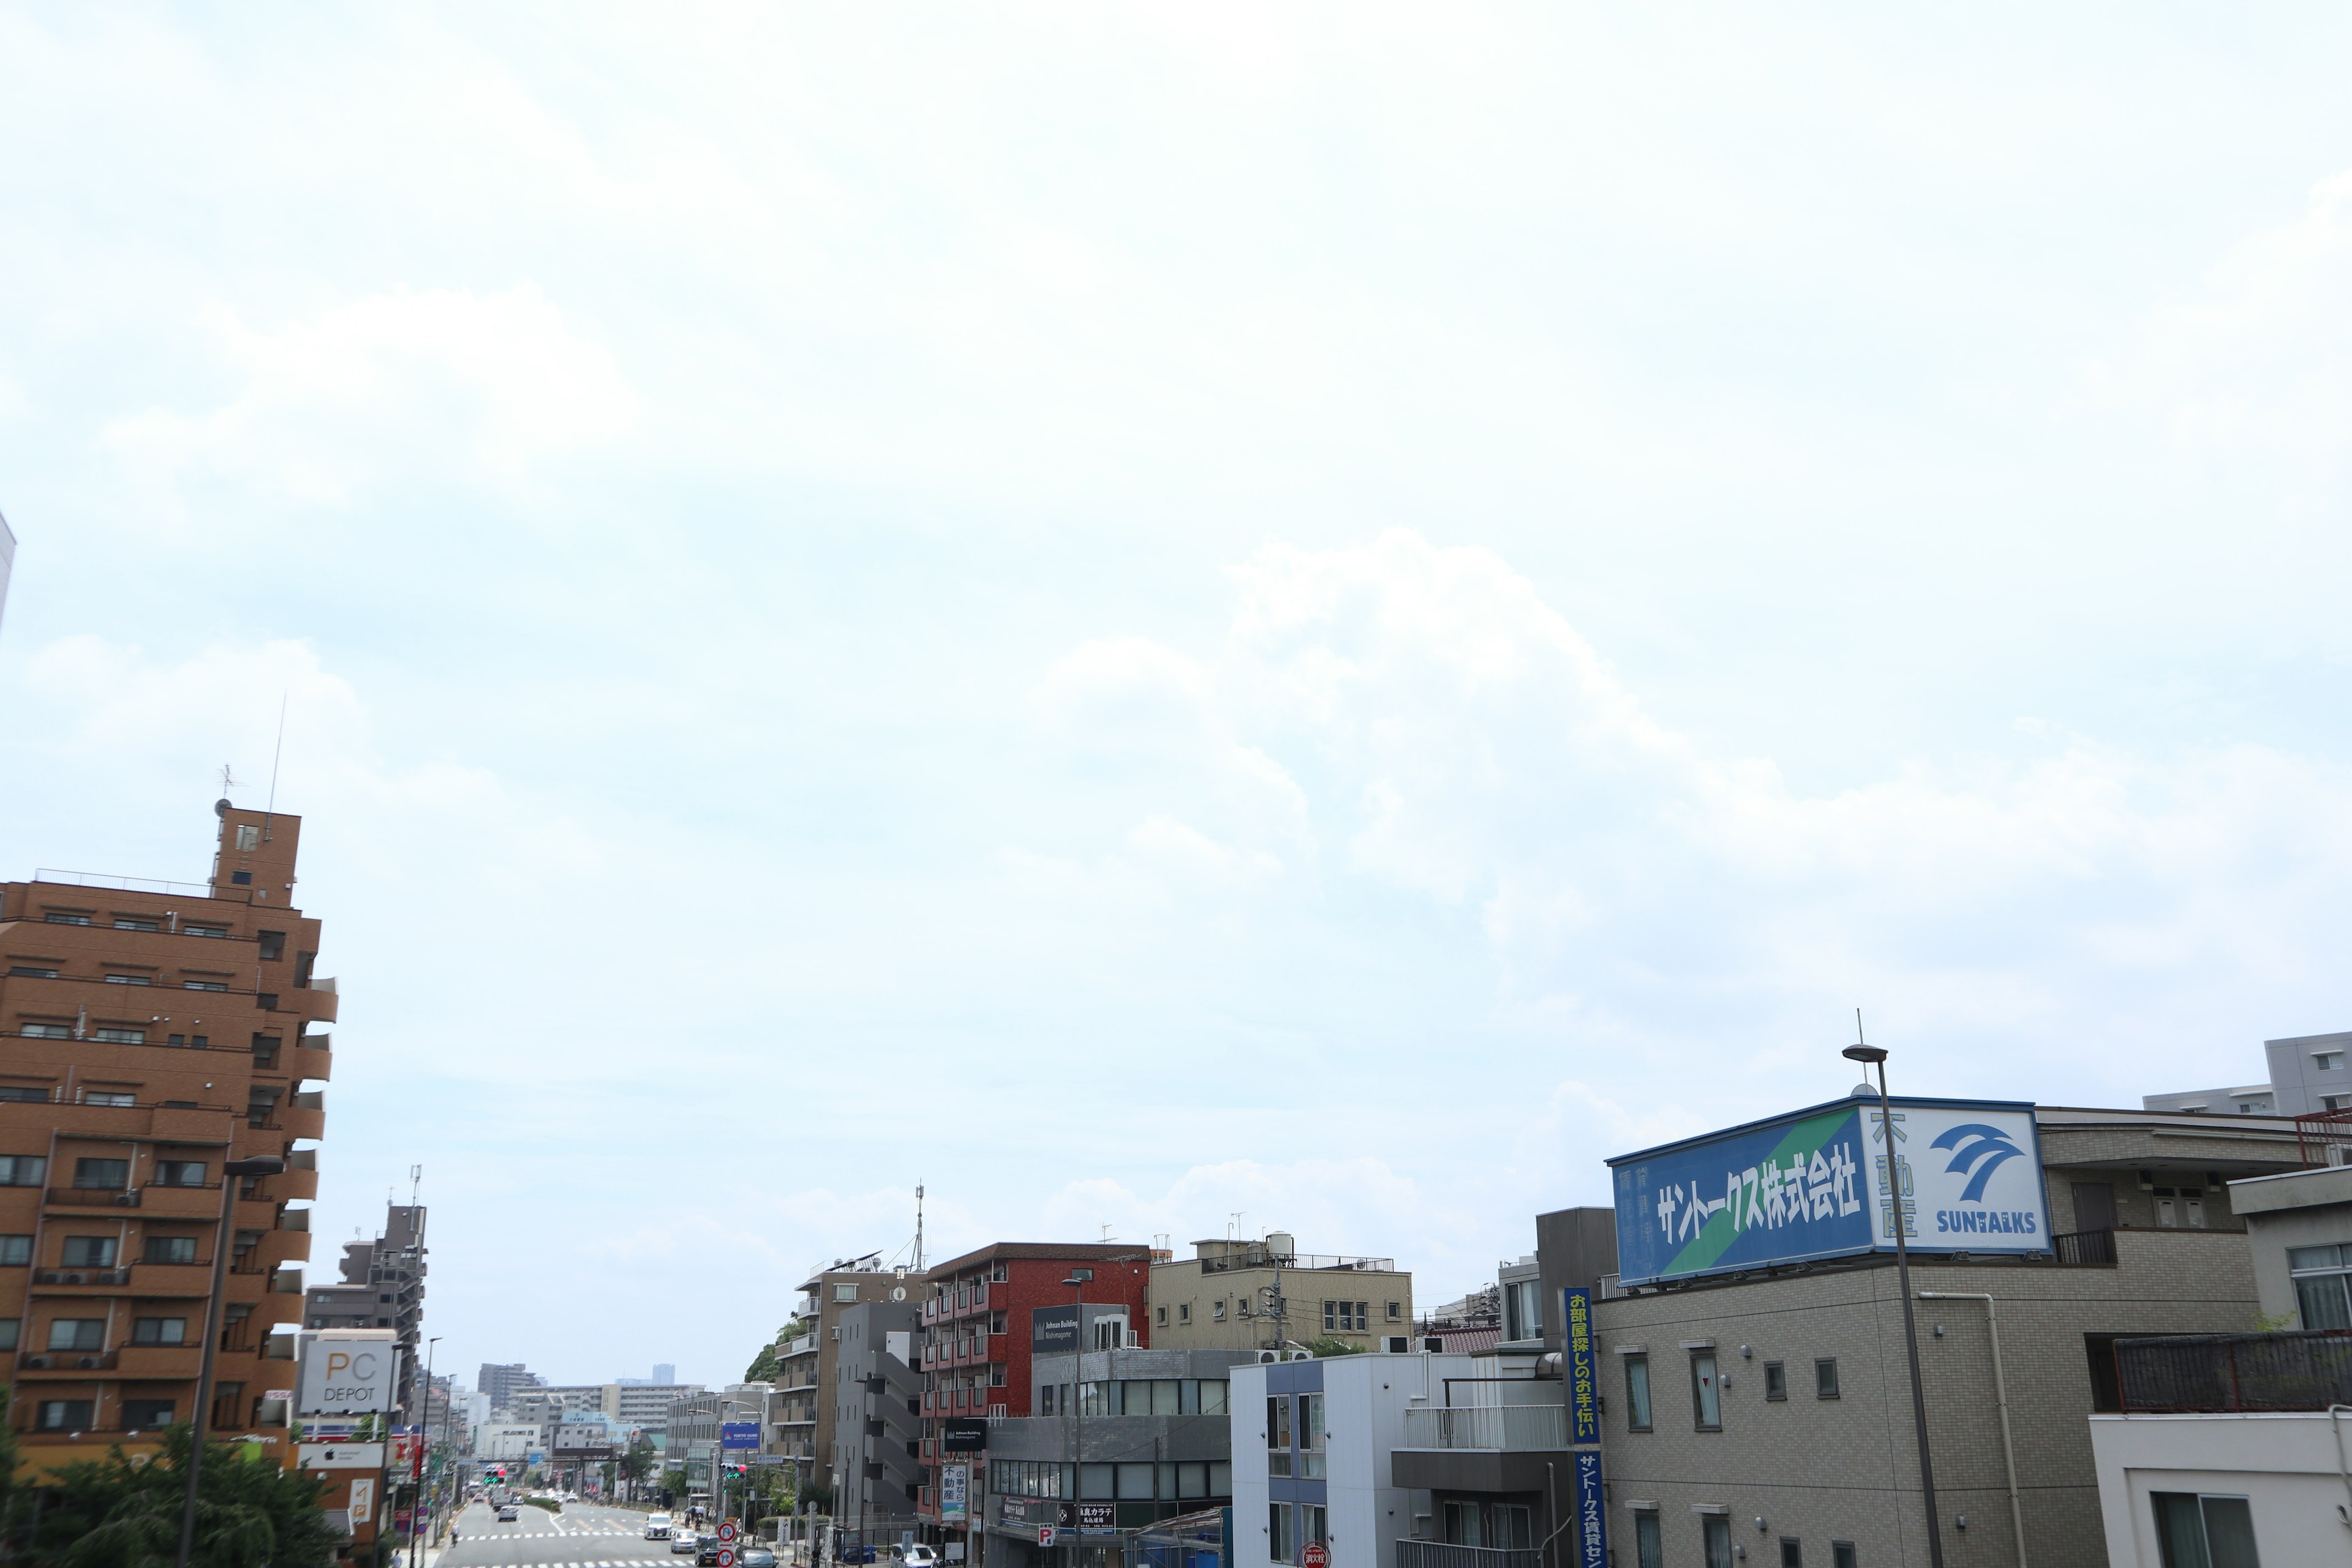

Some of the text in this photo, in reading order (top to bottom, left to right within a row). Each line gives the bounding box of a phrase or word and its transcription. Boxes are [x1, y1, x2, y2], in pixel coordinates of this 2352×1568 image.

[1871, 1113, 1918, 1238] 不動産
[1657, 1142, 1861, 1245] サントークス株式会社
[1937, 1210, 2037, 1234] SUNTALKS
[1061, 1320, 1078, 1329] Building
[326, 1352, 376, 1381] PC
[1570, 1294, 1594, 1437] お部屋探しのお手伝い
[324, 1388, 375, 1401] DEPOT
[944, 1466, 954, 1500] 不動産
[1580, 1455, 1602, 1568] サントークス賃貸セン
[1040, 1529, 1052, 1542] P
[1305, 1553, 1325, 1564] 消火栓
